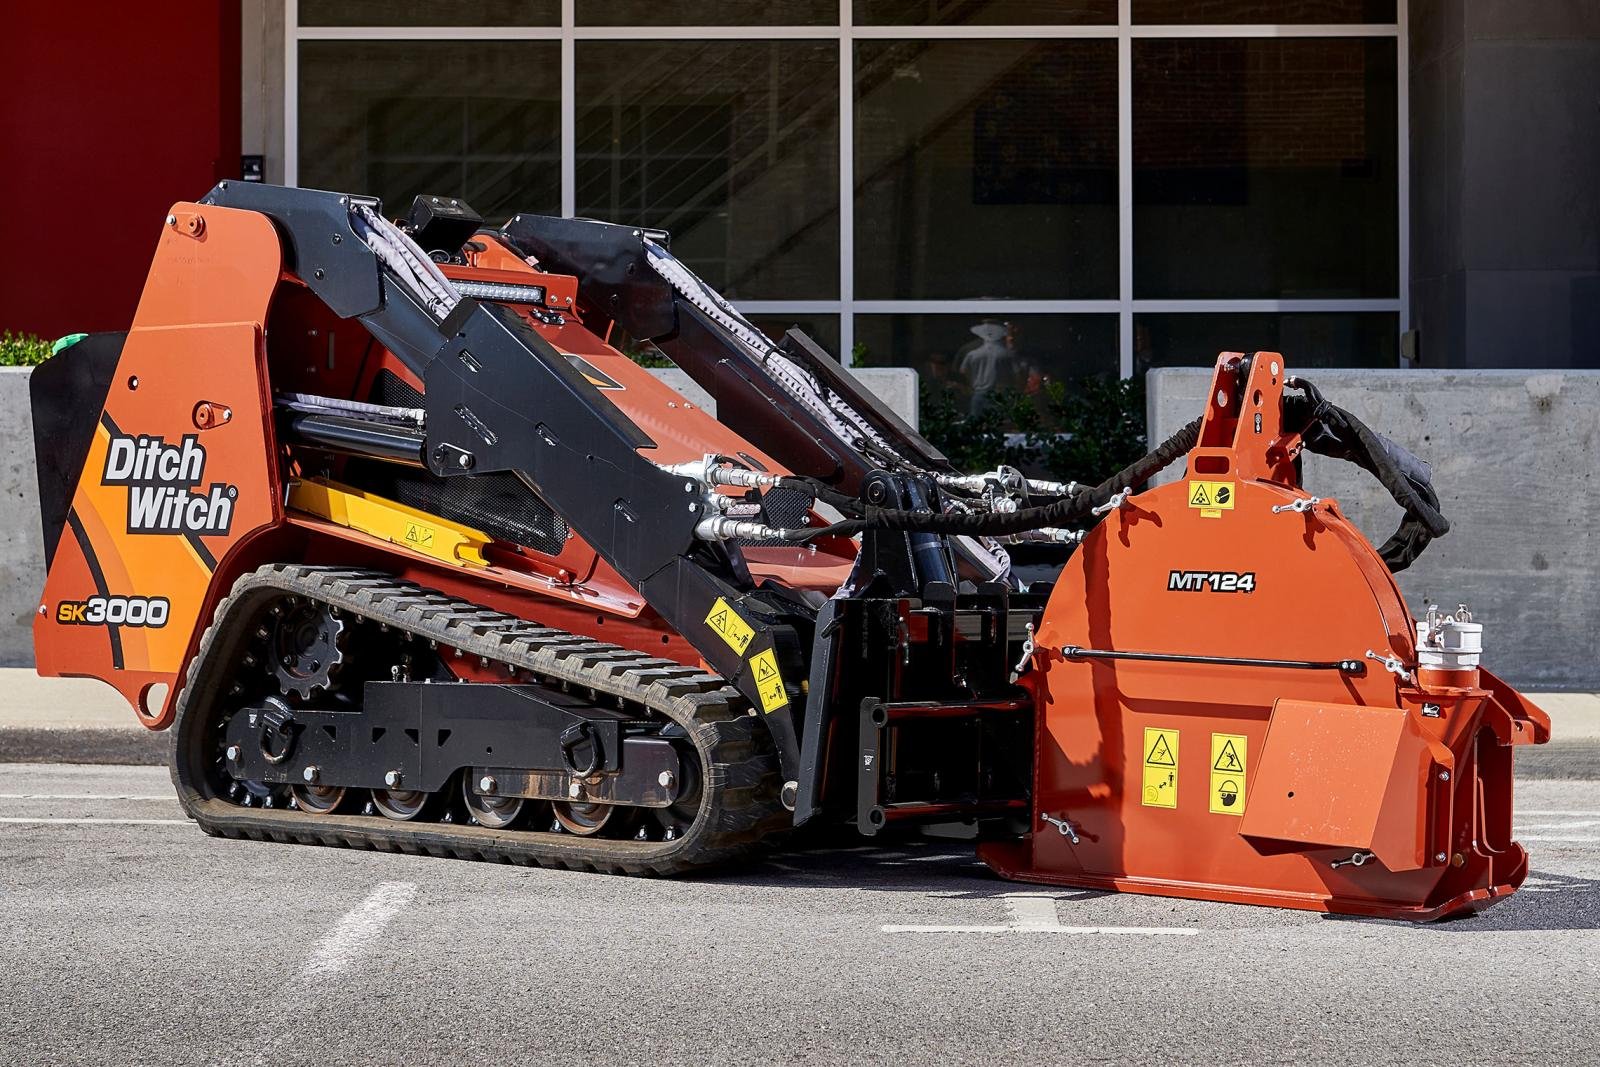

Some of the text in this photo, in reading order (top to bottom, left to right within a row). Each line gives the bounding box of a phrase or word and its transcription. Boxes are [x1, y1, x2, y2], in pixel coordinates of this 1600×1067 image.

[105, 437, 203, 480] Ditch
[1168, 572, 1254, 592] MT124
[58, 598, 168, 625] SK3000
